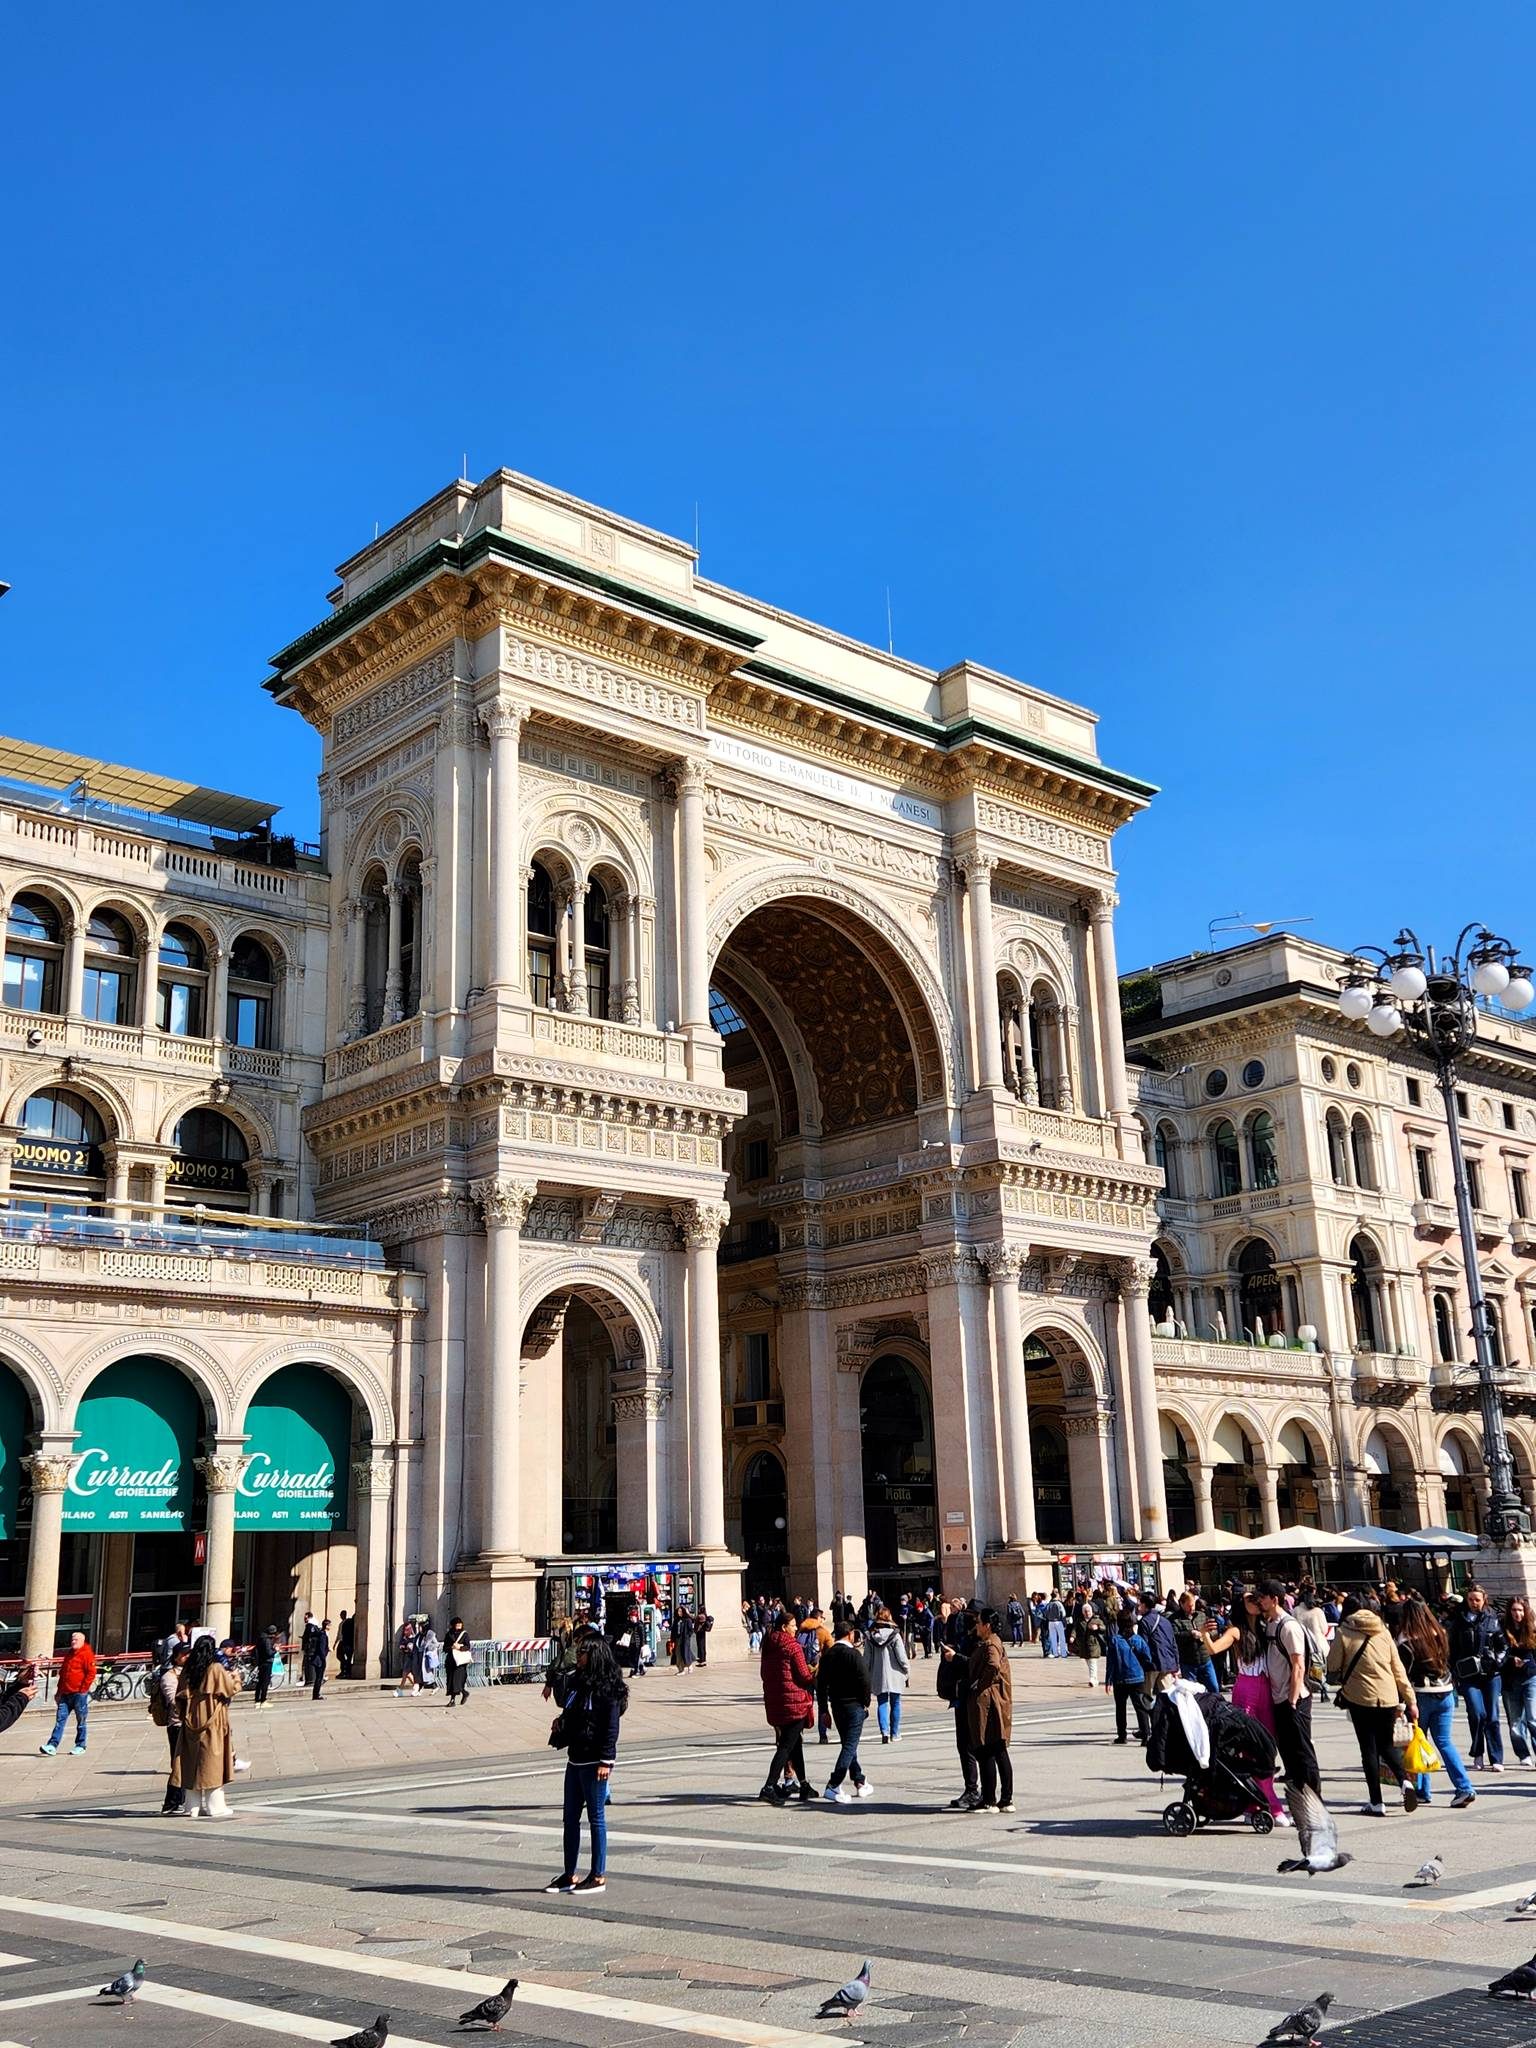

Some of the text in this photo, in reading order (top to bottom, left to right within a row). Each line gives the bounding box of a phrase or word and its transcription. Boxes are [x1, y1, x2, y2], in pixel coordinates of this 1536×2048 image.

[714, 738, 772, 768] VITTORIO
[779, 760, 844, 793] EMANUELE
[880, 793, 930, 820] MILANESI
[13, 1143, 89, 1166] DUOMO 21
[166, 1160, 235, 1180] DUOMO 21
[67, 1448, 179, 1496] Currado
[236, 1452, 335, 1497] Currado
[114, 1487, 178, 1497] GIOIELLERIE
[276, 1489, 334, 1499] GIOIELLERIE
[108, 1511, 129, 1519] ASTI
[140, 1511, 185, 1519] SANREMO
[271, 1511, 289, 1519] ASTI
[300, 1511, 341, 1519] SANREMO
